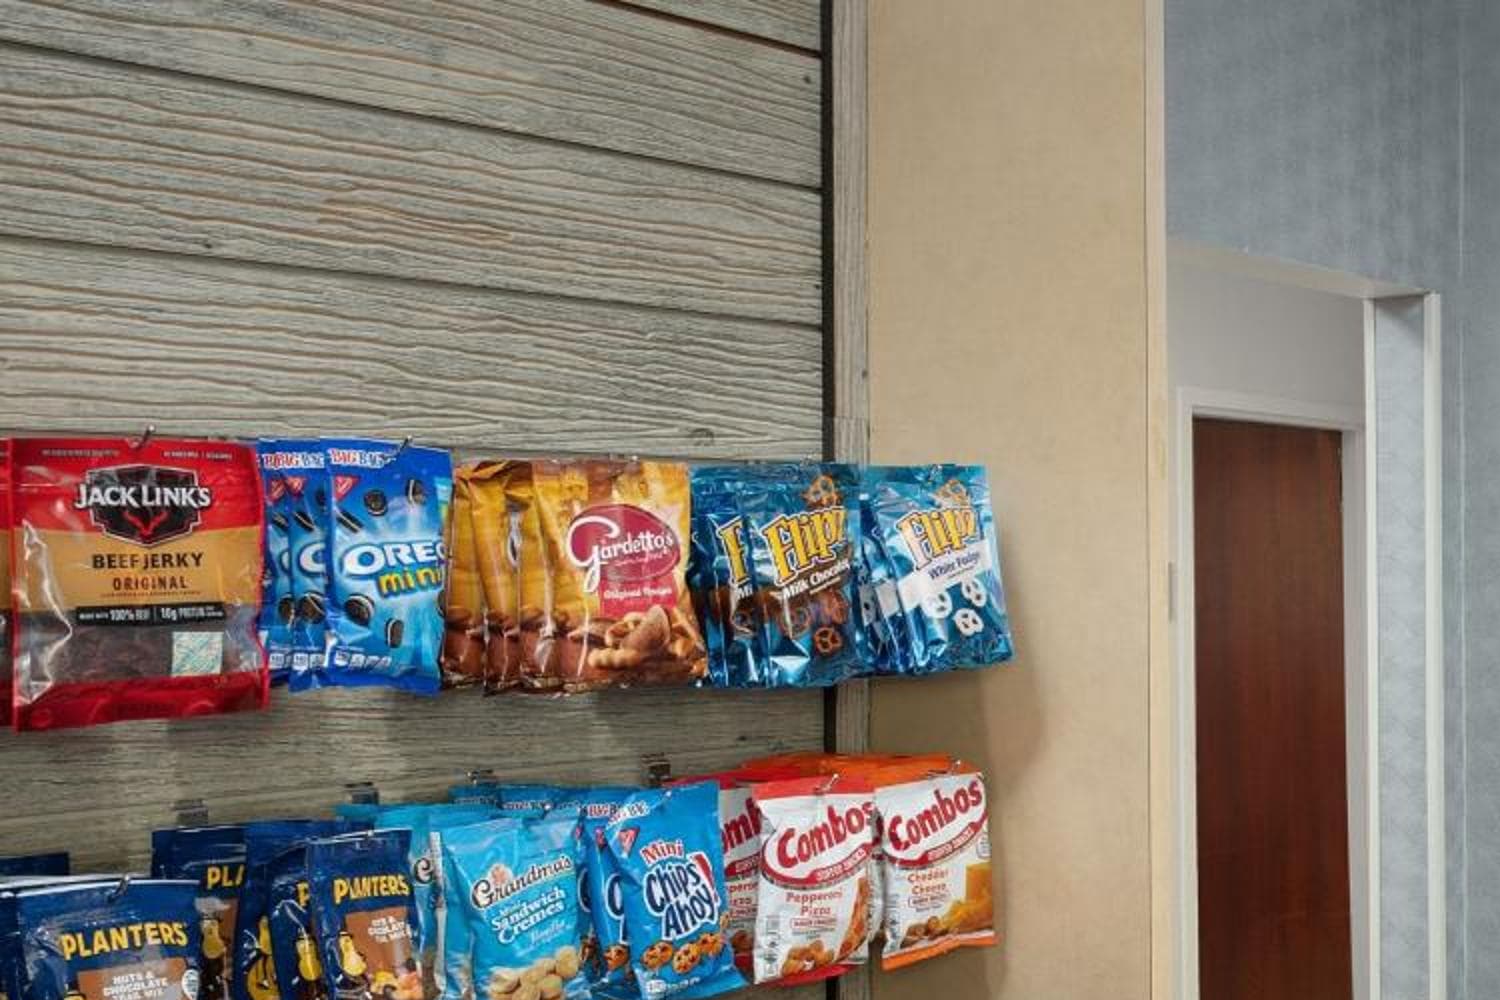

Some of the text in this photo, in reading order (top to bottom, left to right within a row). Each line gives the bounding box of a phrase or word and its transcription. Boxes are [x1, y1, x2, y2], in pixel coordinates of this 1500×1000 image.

[74, 484, 139, 509] JACK
[93, 552, 204, 570] BEEF JERKY
[567, 515, 674, 593] Gardetto's
[113, 576, 188, 591] ORIGINAL
[783, 578, 808, 601] Milk
[888, 780, 982, 851] Combos
[640, 839, 684, 864] Mini
[777, 802, 875, 869] Combos
[334, 875, 410, 904] PLANTERS
[644, 861, 702, 916] Chips
[491, 885, 566, 931] Sandwich
[498, 900, 564, 943] Cremes
[62, 923, 188, 960] PLANTERS
